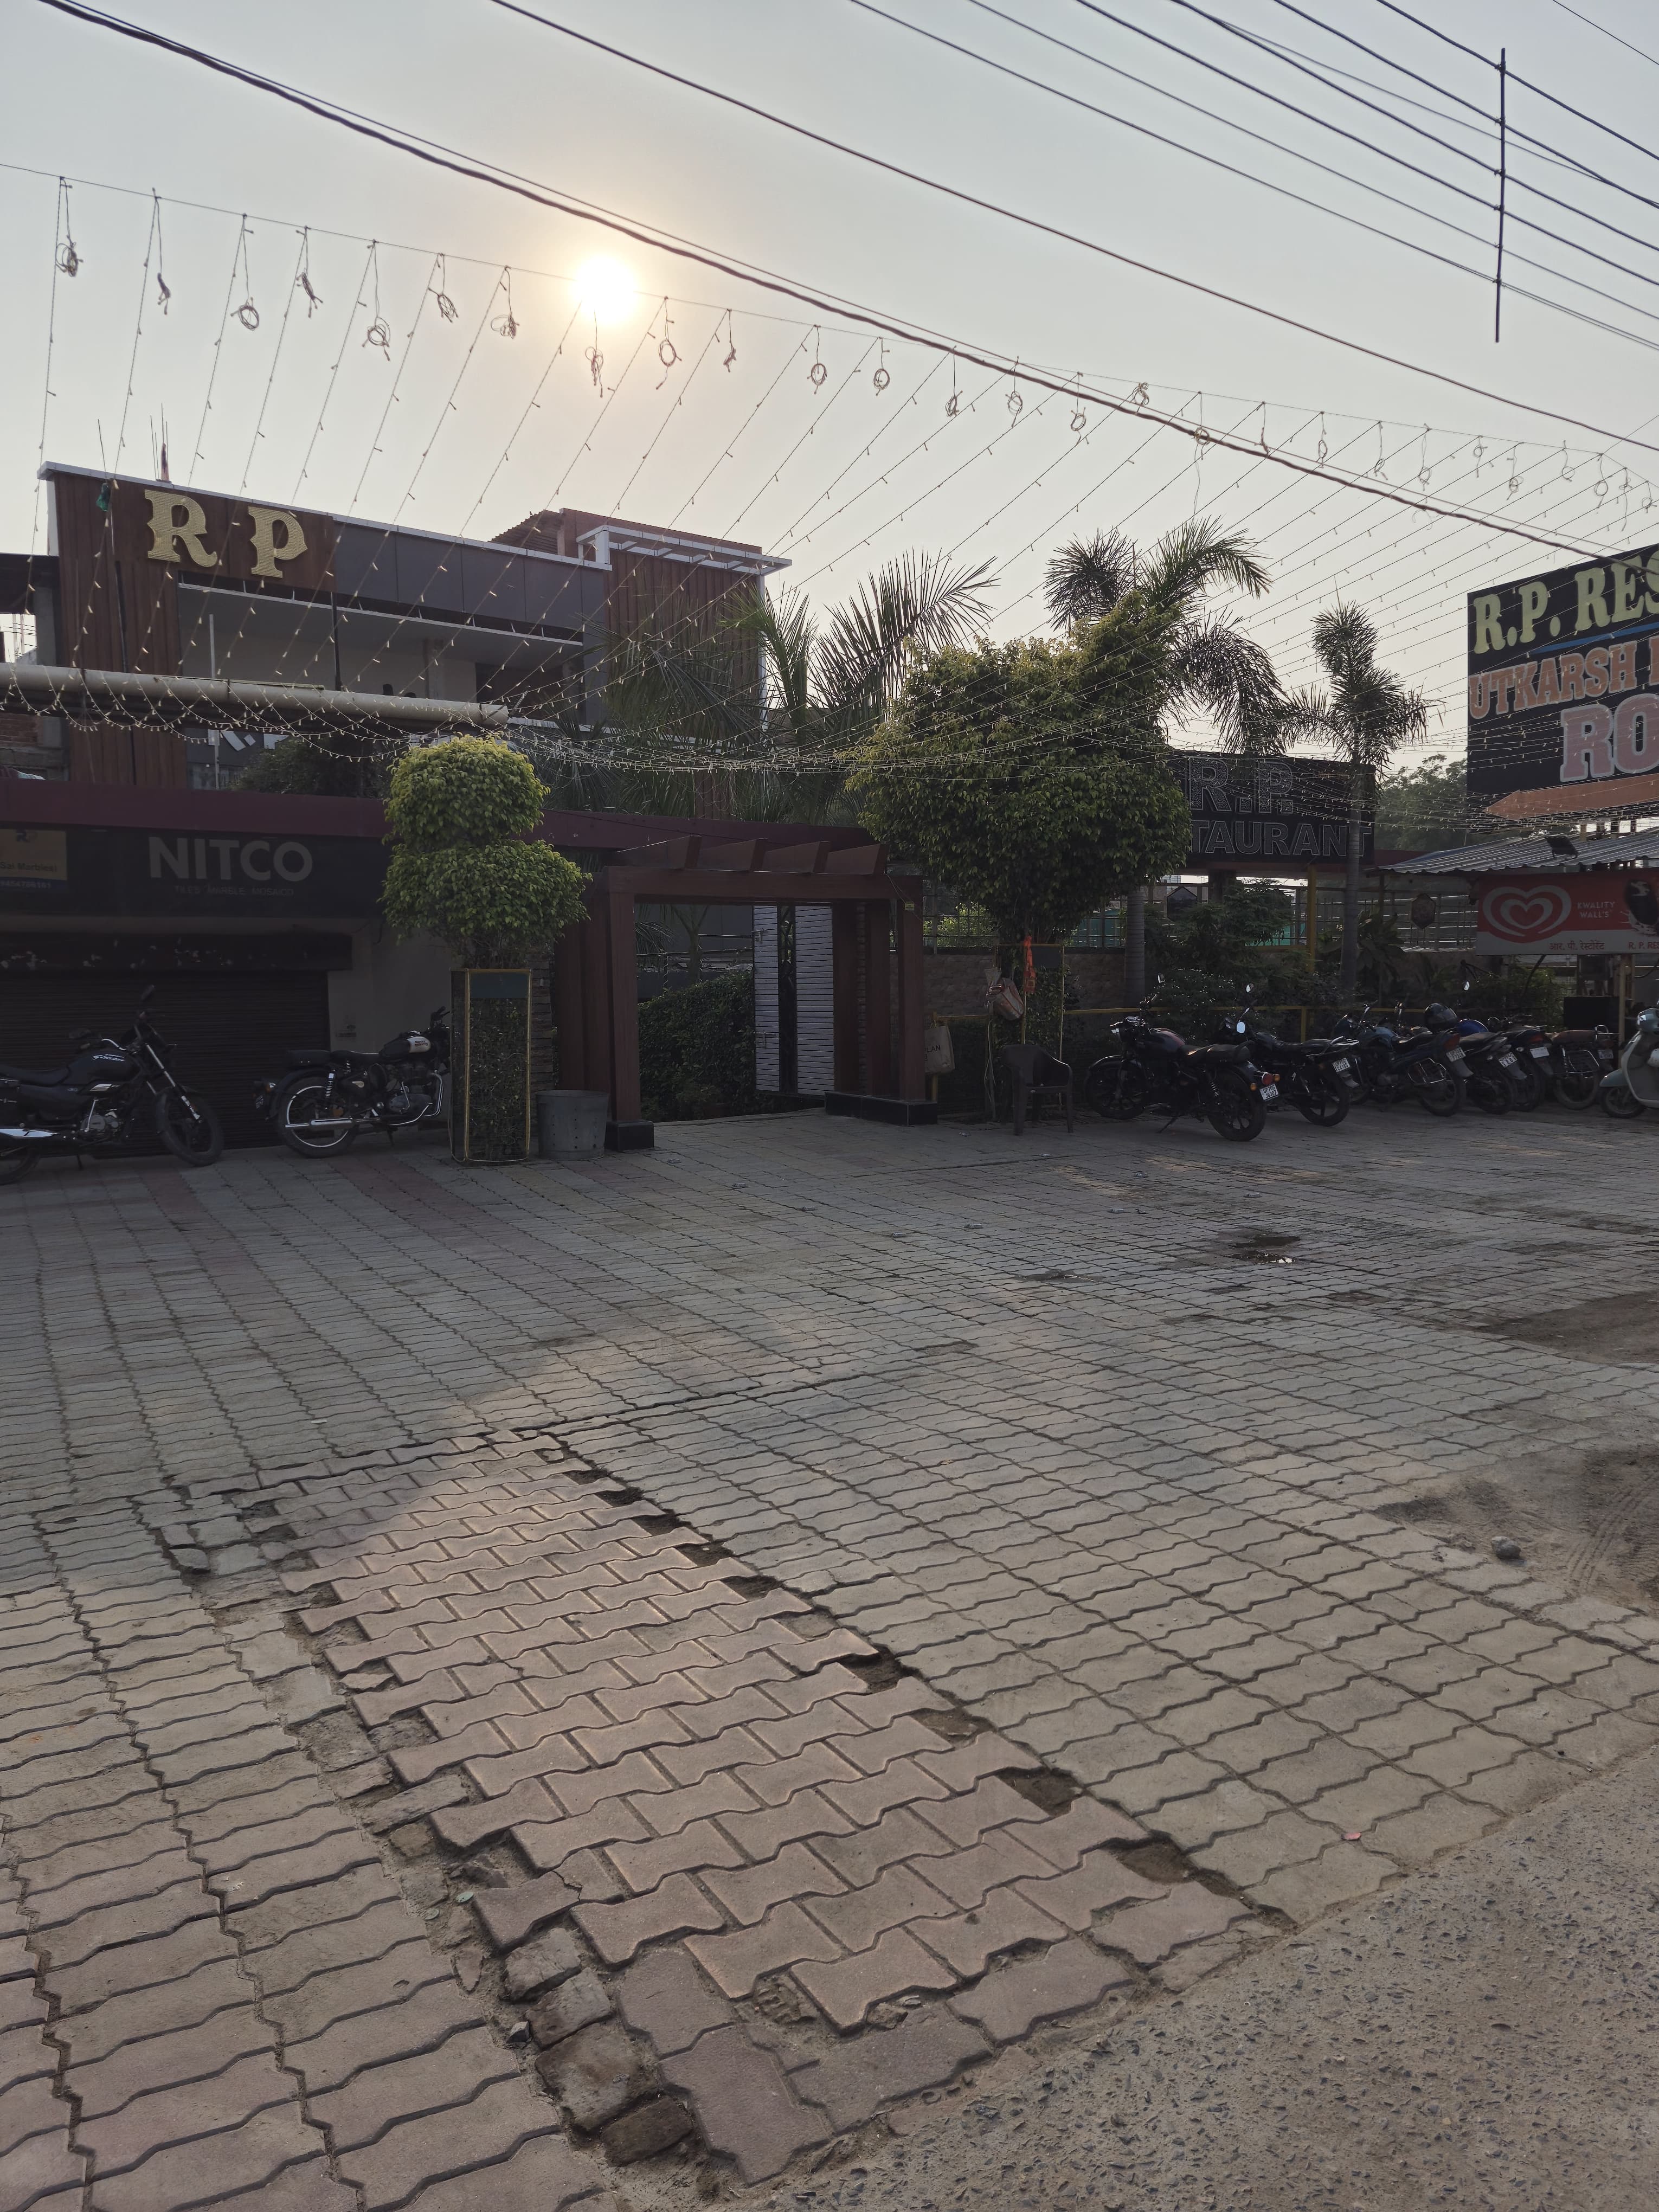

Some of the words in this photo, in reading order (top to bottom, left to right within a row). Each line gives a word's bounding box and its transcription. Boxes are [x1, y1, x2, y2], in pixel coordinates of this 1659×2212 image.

[1473, 581, 1561, 654] R.P.
[1468, 640, 1637, 719] UTKARSH
[1188, 757, 1294, 815] R.P.
[149, 836, 313, 882] NITCO
[1191, 820, 1372, 858] TAURANT
